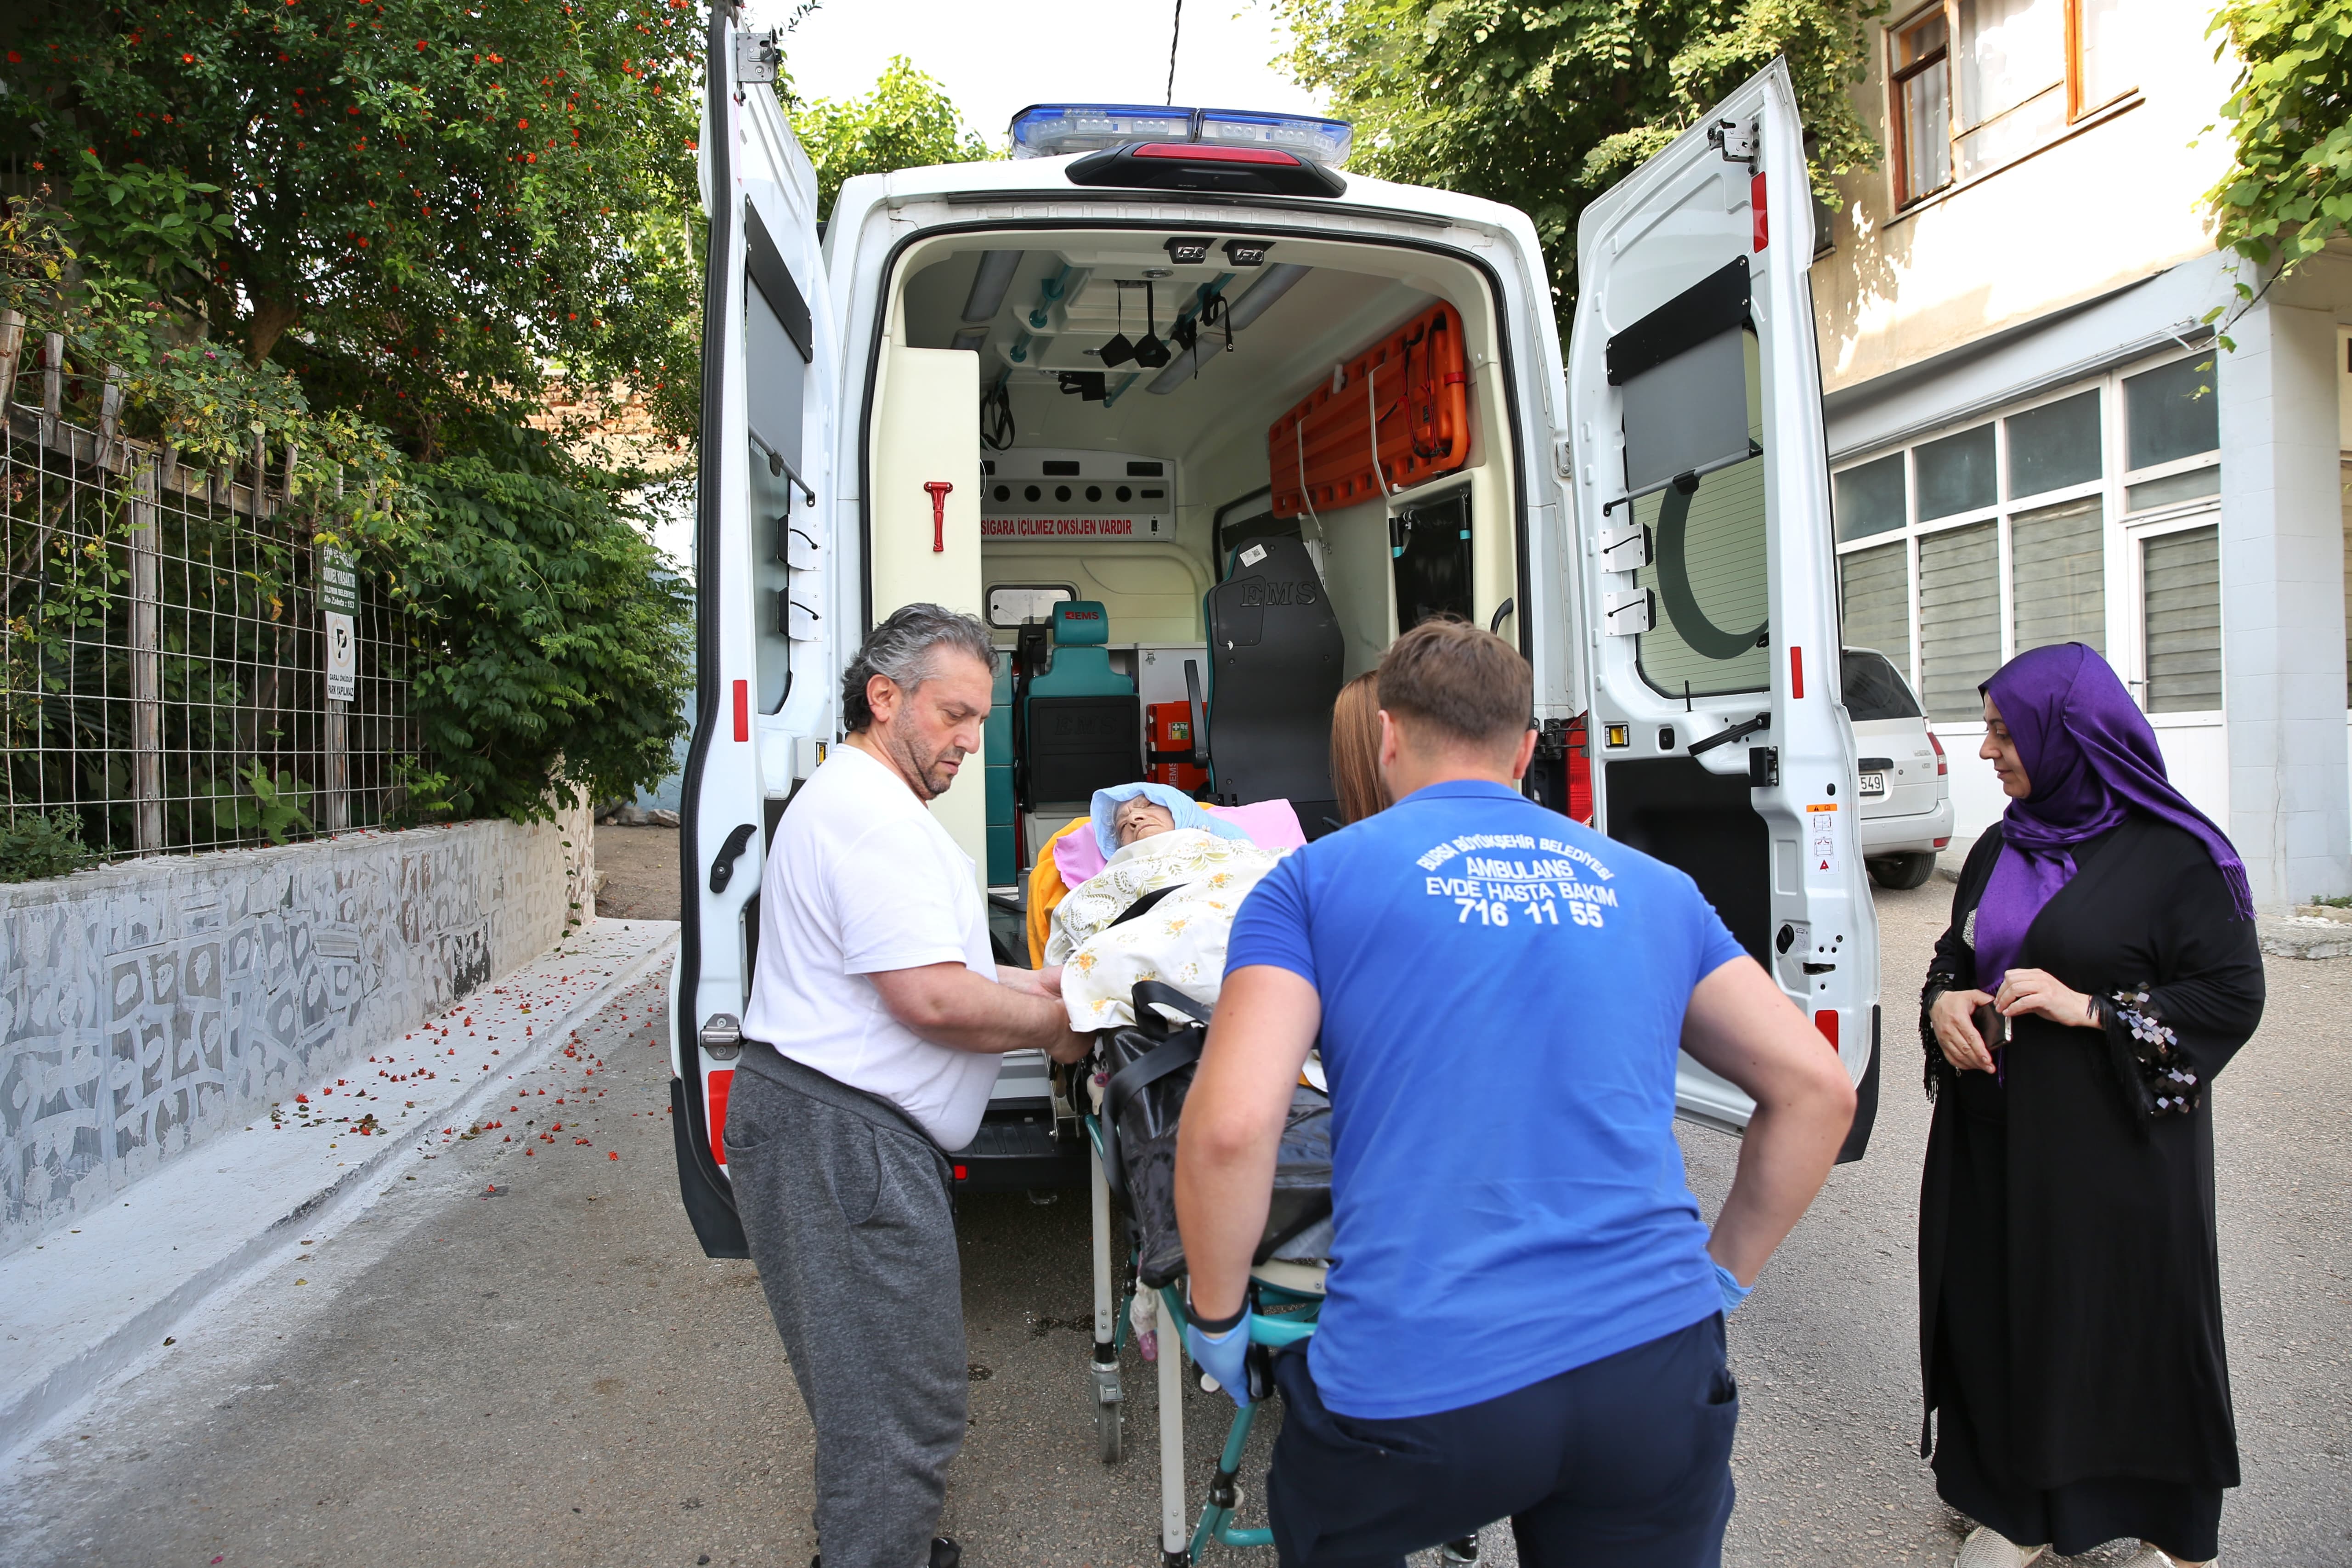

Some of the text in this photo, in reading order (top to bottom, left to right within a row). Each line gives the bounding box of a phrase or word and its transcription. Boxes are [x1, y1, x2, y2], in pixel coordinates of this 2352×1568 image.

[981, 518, 1132, 536] SİGARA İÇİLMEZ OKSİJEN VARDIR
[1240, 581, 1317, 607] EMS
[1075, 611, 1099, 620] EMS
[340, 674, 353, 683] ÖNÜDÜR
[328, 685, 353, 696] PARK YAPILMAZ
[1860, 776, 1881, 790] 549
[1416, 833, 1615, 881] BURSA BÜYÜKŞEHİR BELEDİYESİ
[1466, 856, 1574, 880] AMBULANS
[1426, 876, 1619, 908] EVDE HASTA BAKIM
[1454, 897, 1604, 928] 716 11 55
